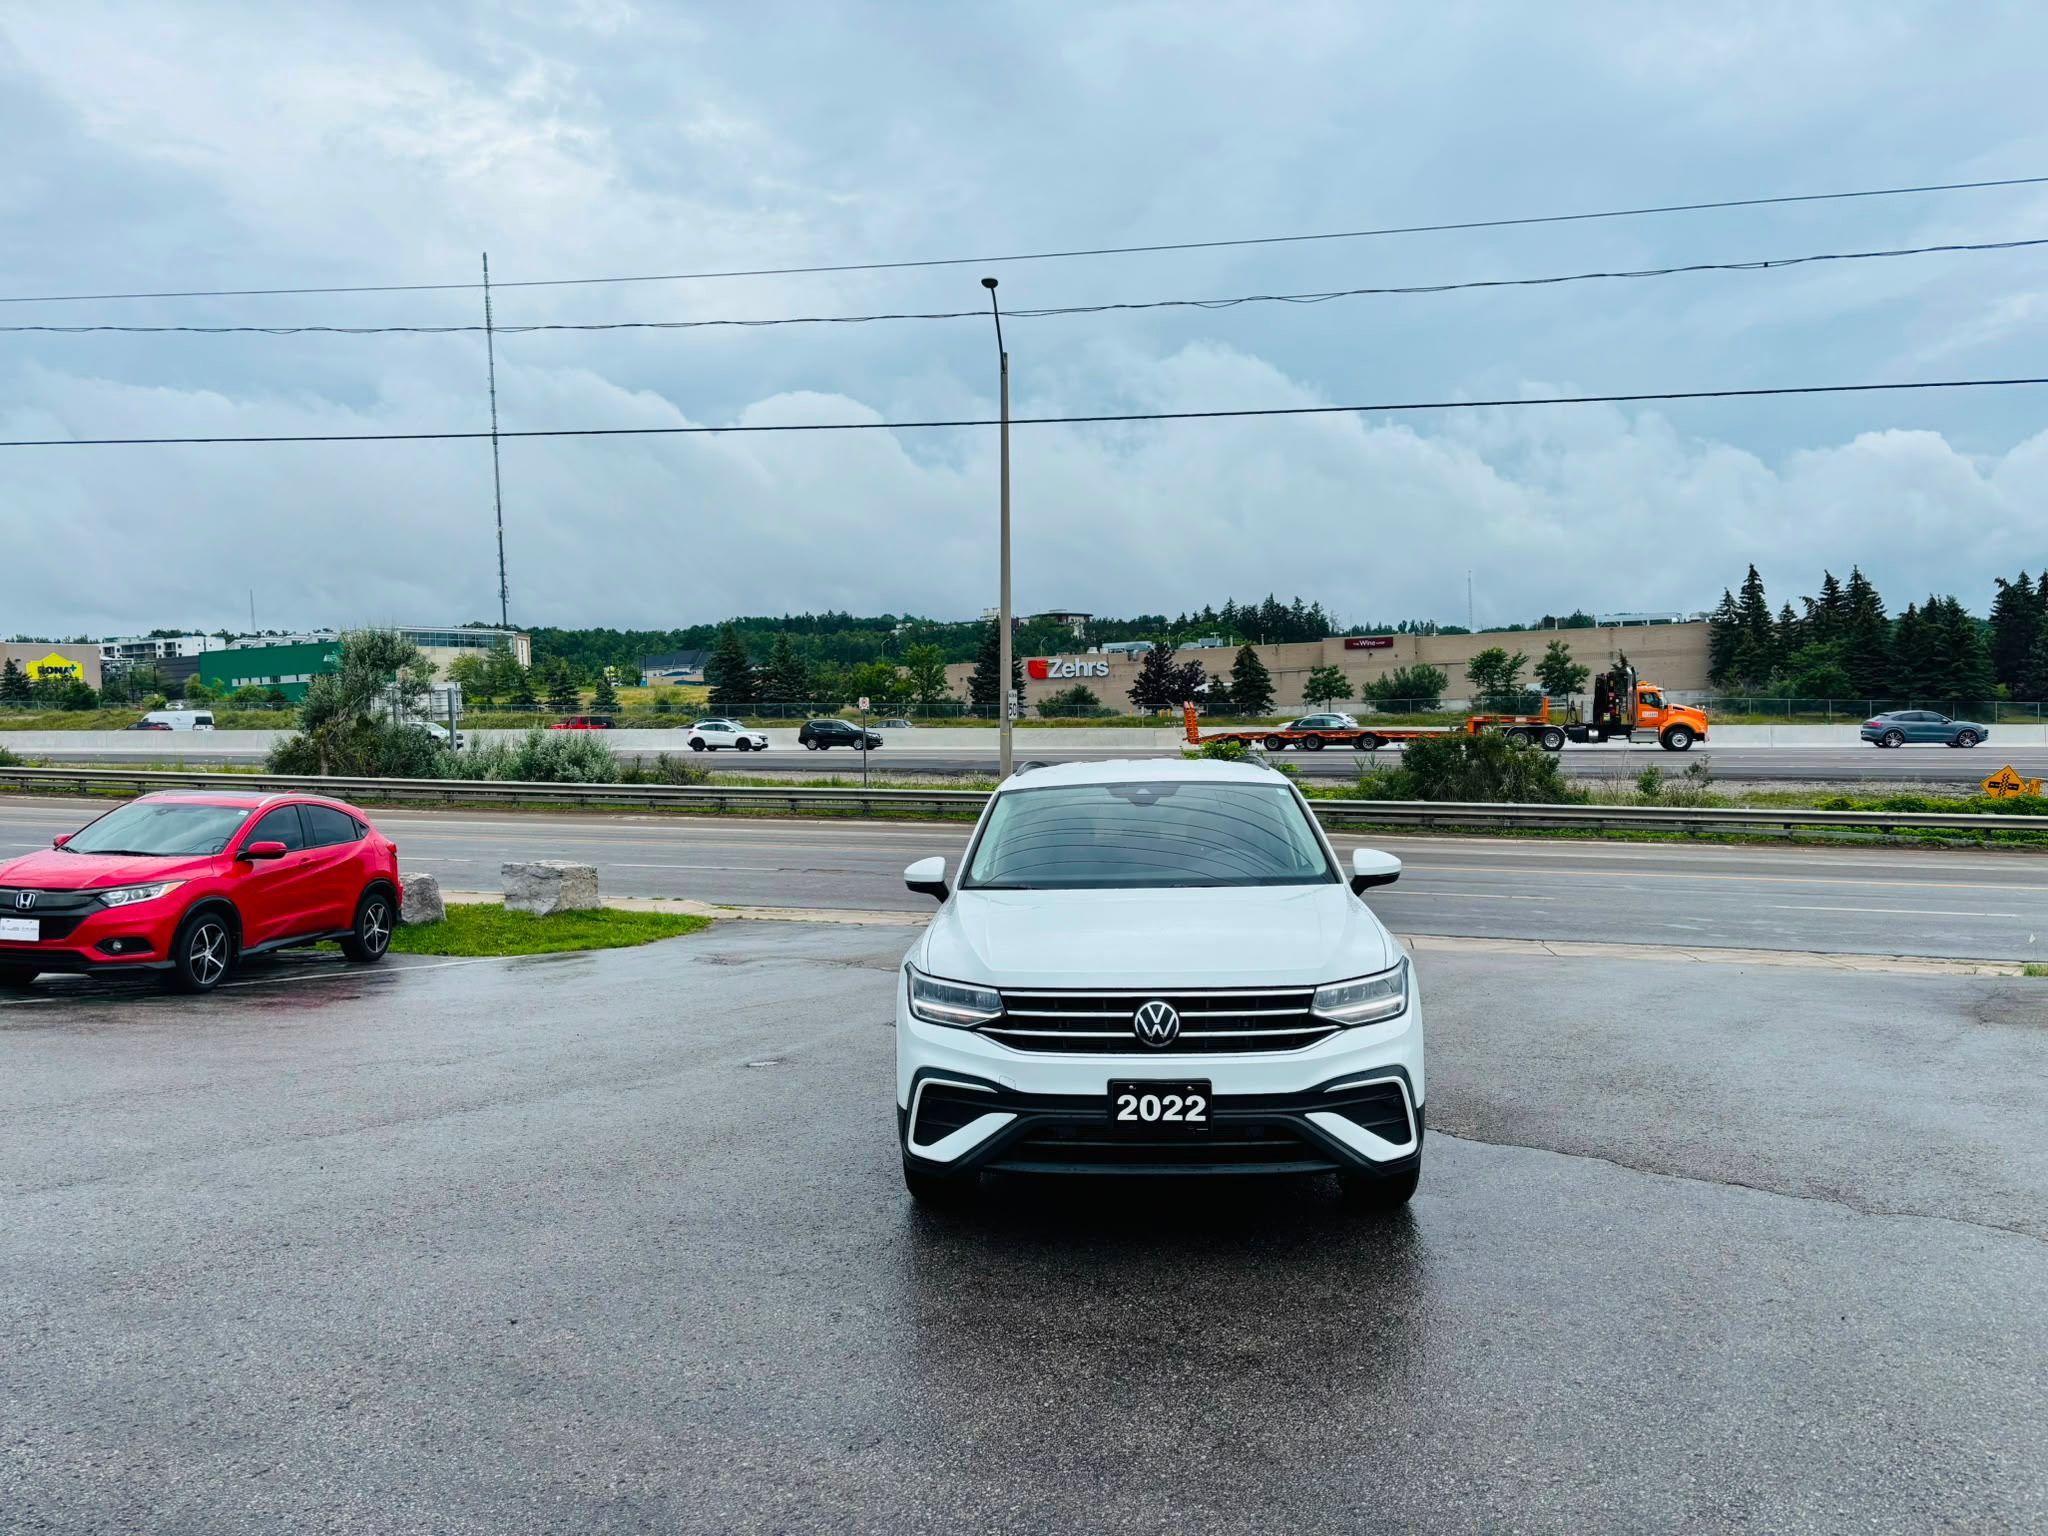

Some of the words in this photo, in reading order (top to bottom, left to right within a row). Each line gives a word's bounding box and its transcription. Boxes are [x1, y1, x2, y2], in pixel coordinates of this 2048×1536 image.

[1048, 658, 1109, 678] Zehrs
[1009, 702, 1017, 716] 50
[1117, 1094, 1206, 1121] 2022
